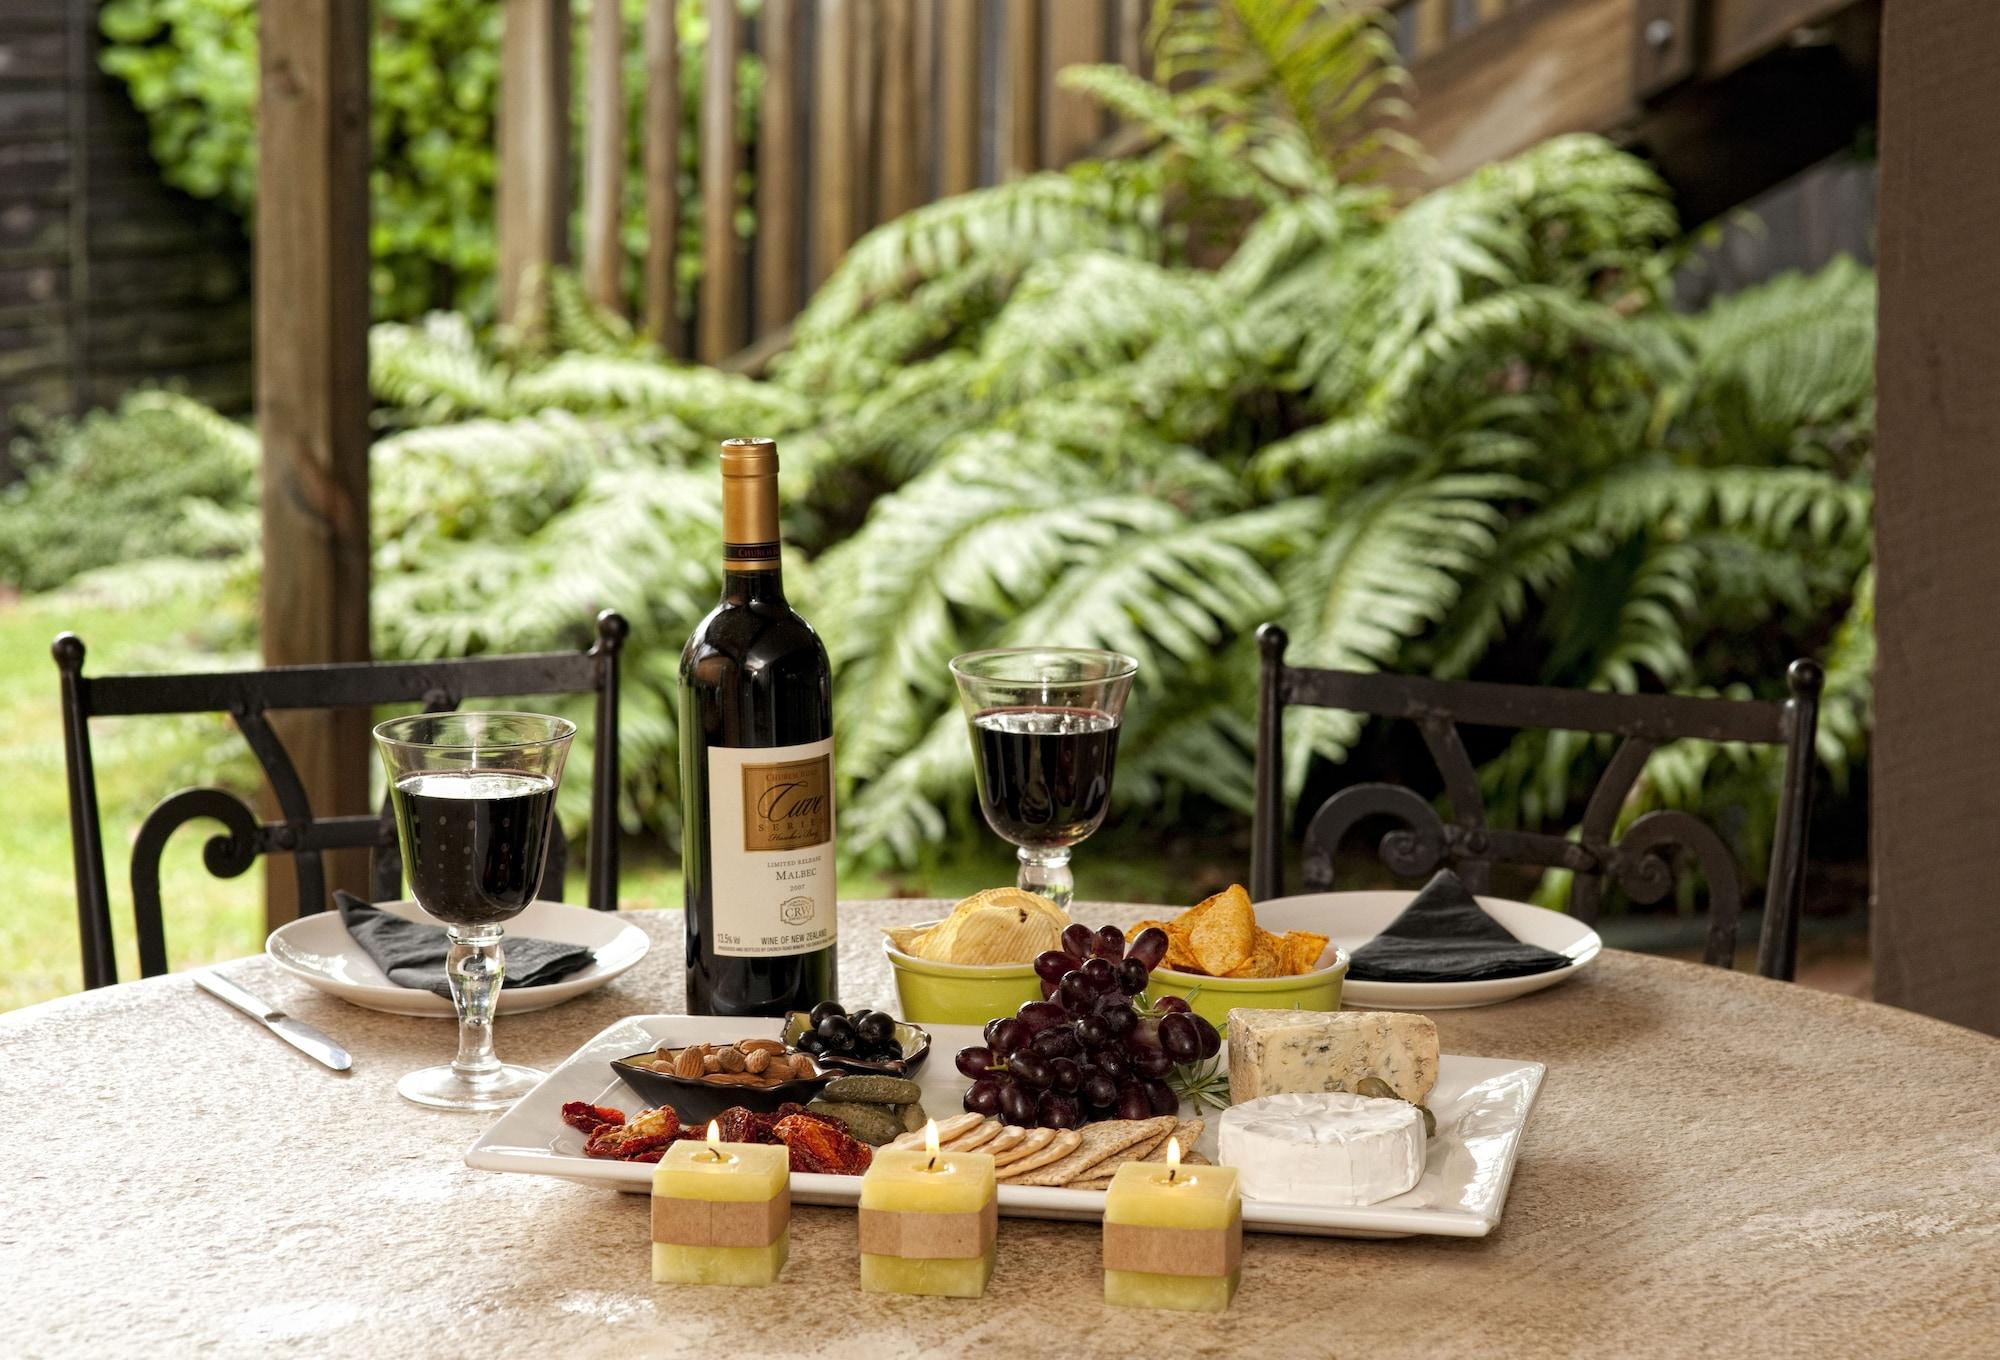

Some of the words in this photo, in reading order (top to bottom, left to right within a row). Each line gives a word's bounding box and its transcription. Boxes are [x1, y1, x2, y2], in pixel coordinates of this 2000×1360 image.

[767, 860, 796, 868] LIMITED
[798, 855, 822, 865] RELEASE
[776, 868, 816, 880] MALBEC
[785, 904, 811, 917] CRW
[760, 936, 778, 945] WINE
[780, 935, 789, 944] OF
[791, 934, 805, 943] NEW
[806, 928, 827, 941] ZEALAND
